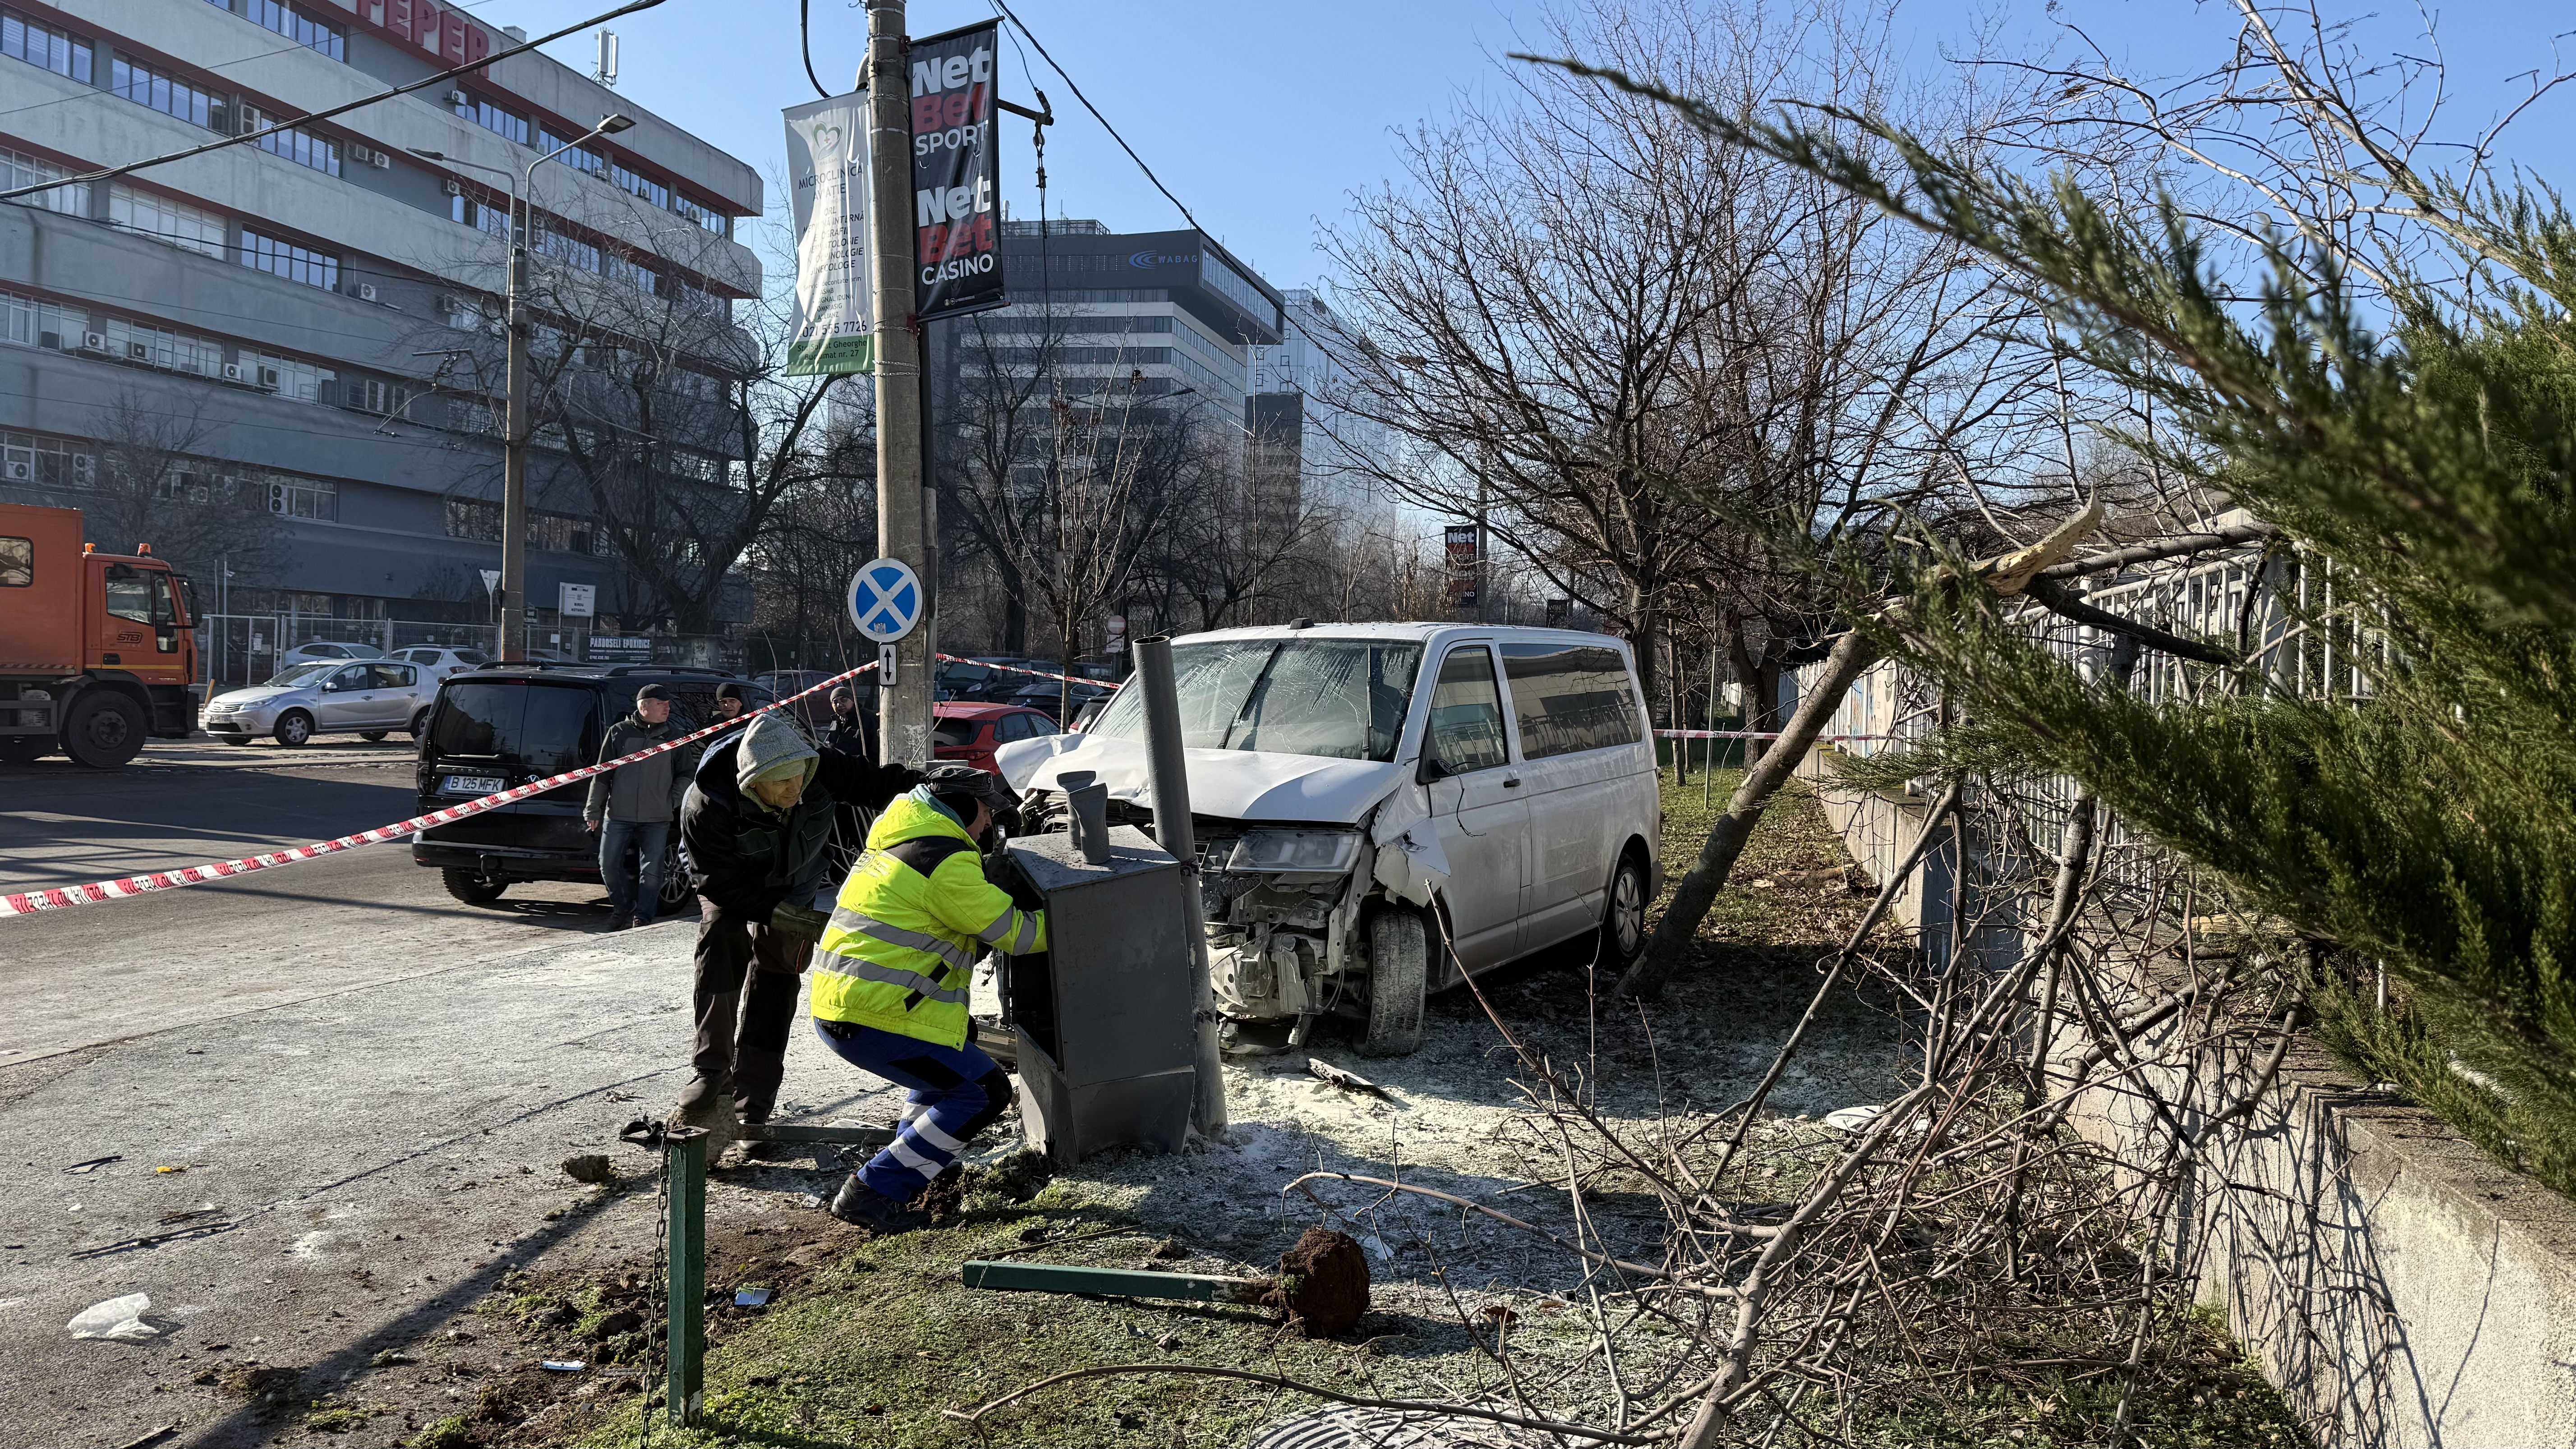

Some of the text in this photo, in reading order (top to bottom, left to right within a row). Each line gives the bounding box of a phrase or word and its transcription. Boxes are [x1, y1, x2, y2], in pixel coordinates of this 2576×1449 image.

[913, 46, 990, 97] Net
[913, 84, 990, 135] Bet
[915, 120, 989, 156] SPORT
[799, 165, 863, 189] MICROCLINICA
[824, 206, 837, 216] ORL
[917, 176, 991, 227] Net
[919, 214, 993, 264] Bet
[1158, 255, 1198, 263] WABAG
[922, 254, 994, 285] CASINO
[802, 321, 867, 337] 021 555 7726
[811, 343, 832, 351] Solat
[833, 339, 867, 348] Gheorghe
[1447, 531, 1474, 543] Net
[117, 633, 141, 642] STB
[451, 777, 460, 788] B
[462, 777, 477, 790] 125
[478, 778, 501, 791] MFK
